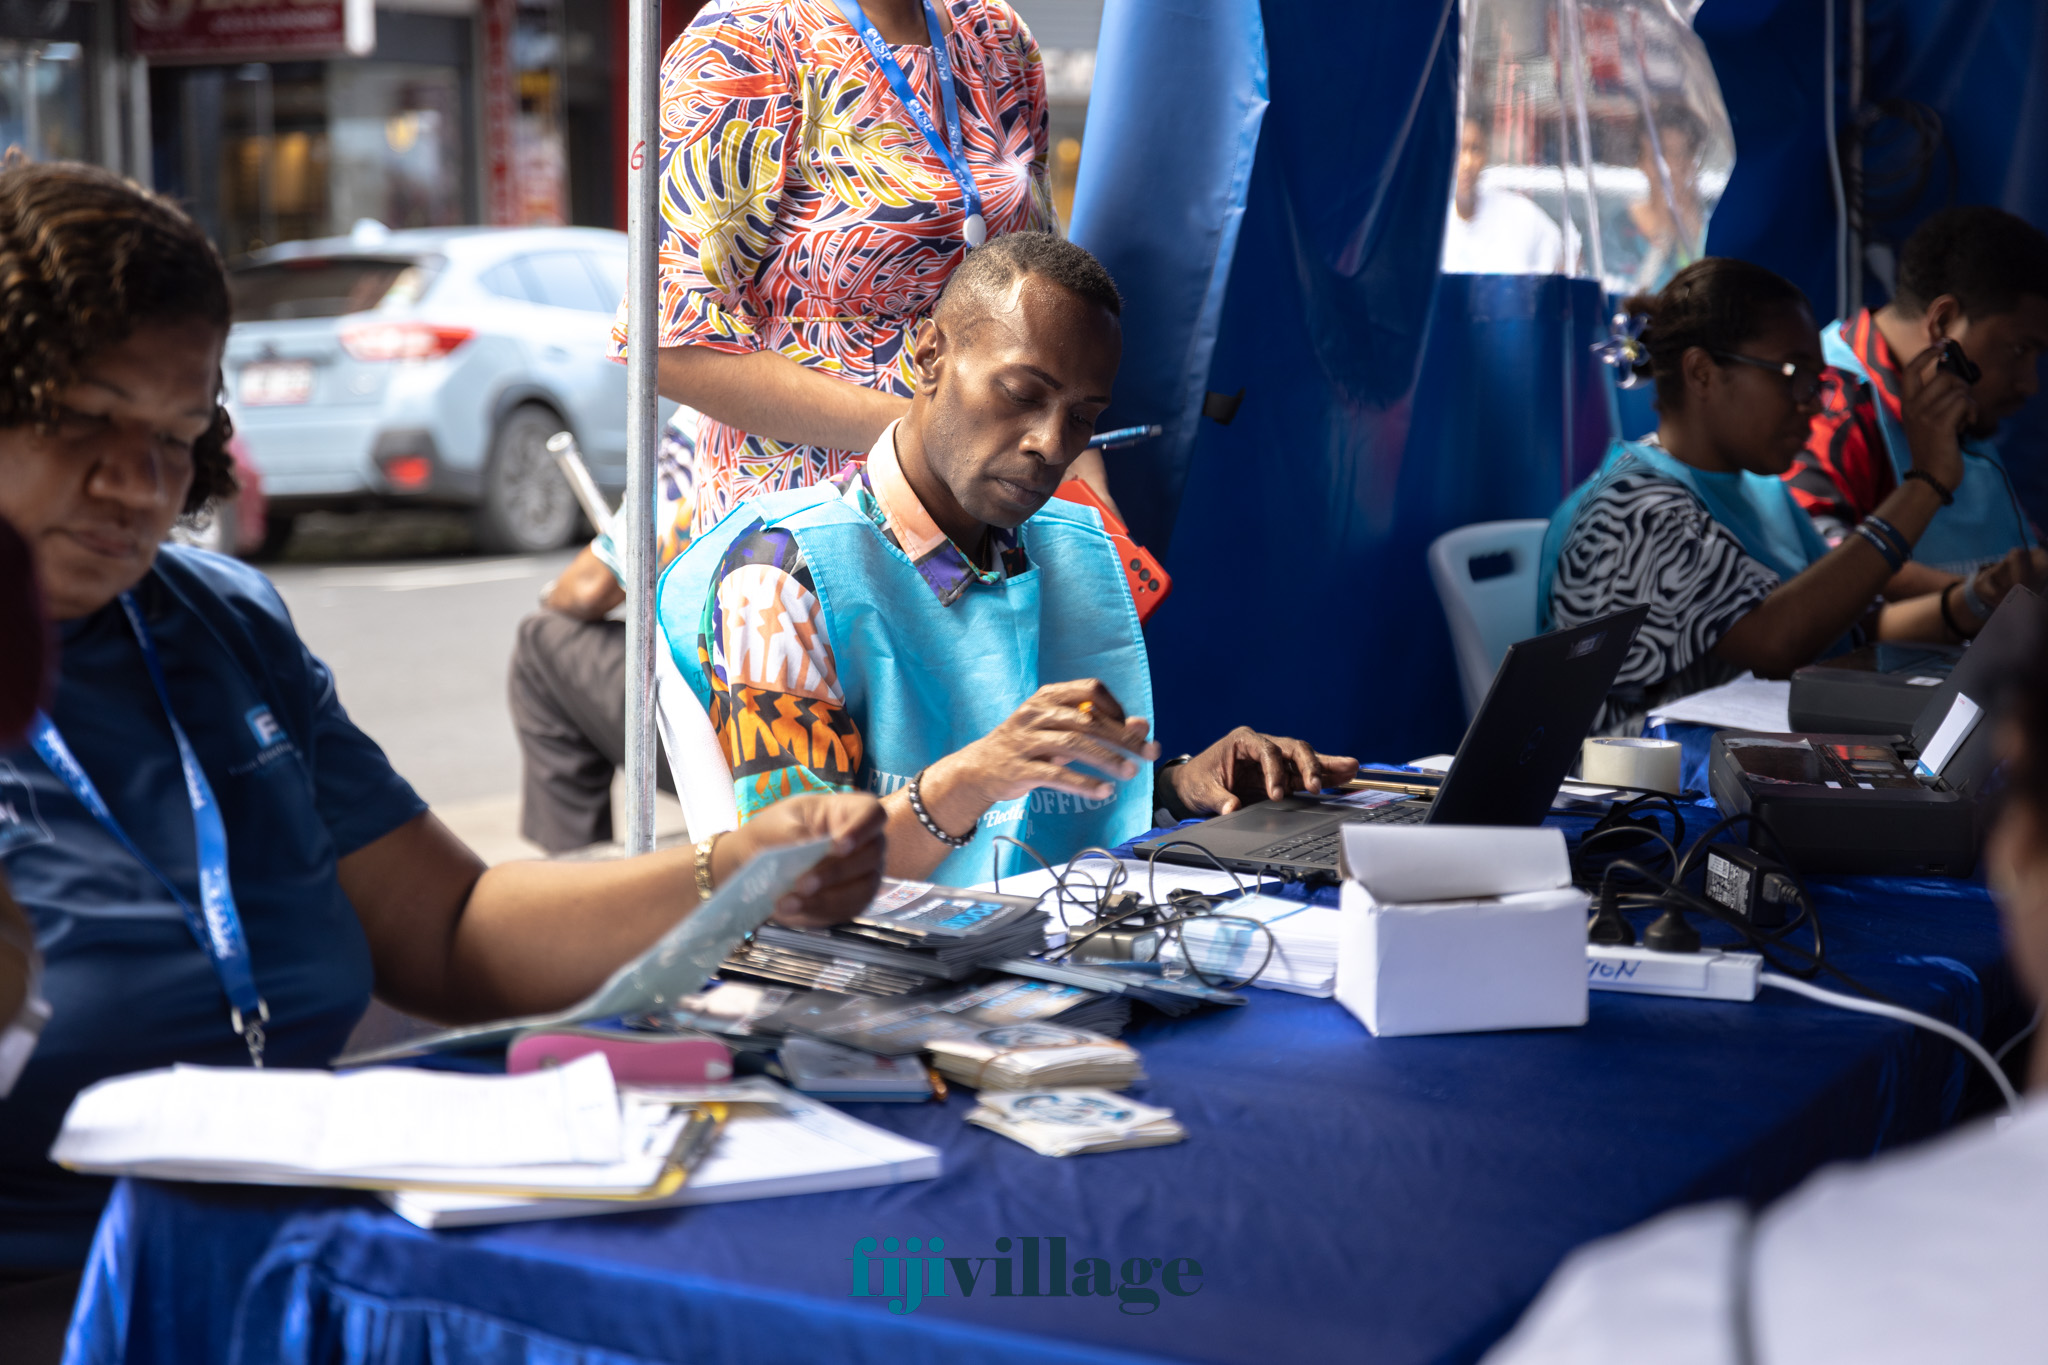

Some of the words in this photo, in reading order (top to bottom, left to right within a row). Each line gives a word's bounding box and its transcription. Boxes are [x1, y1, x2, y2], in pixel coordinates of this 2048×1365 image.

[872, 37, 893, 61] USP
[916, 108, 935, 132] USP
[631, 140, 645, 170] 6
